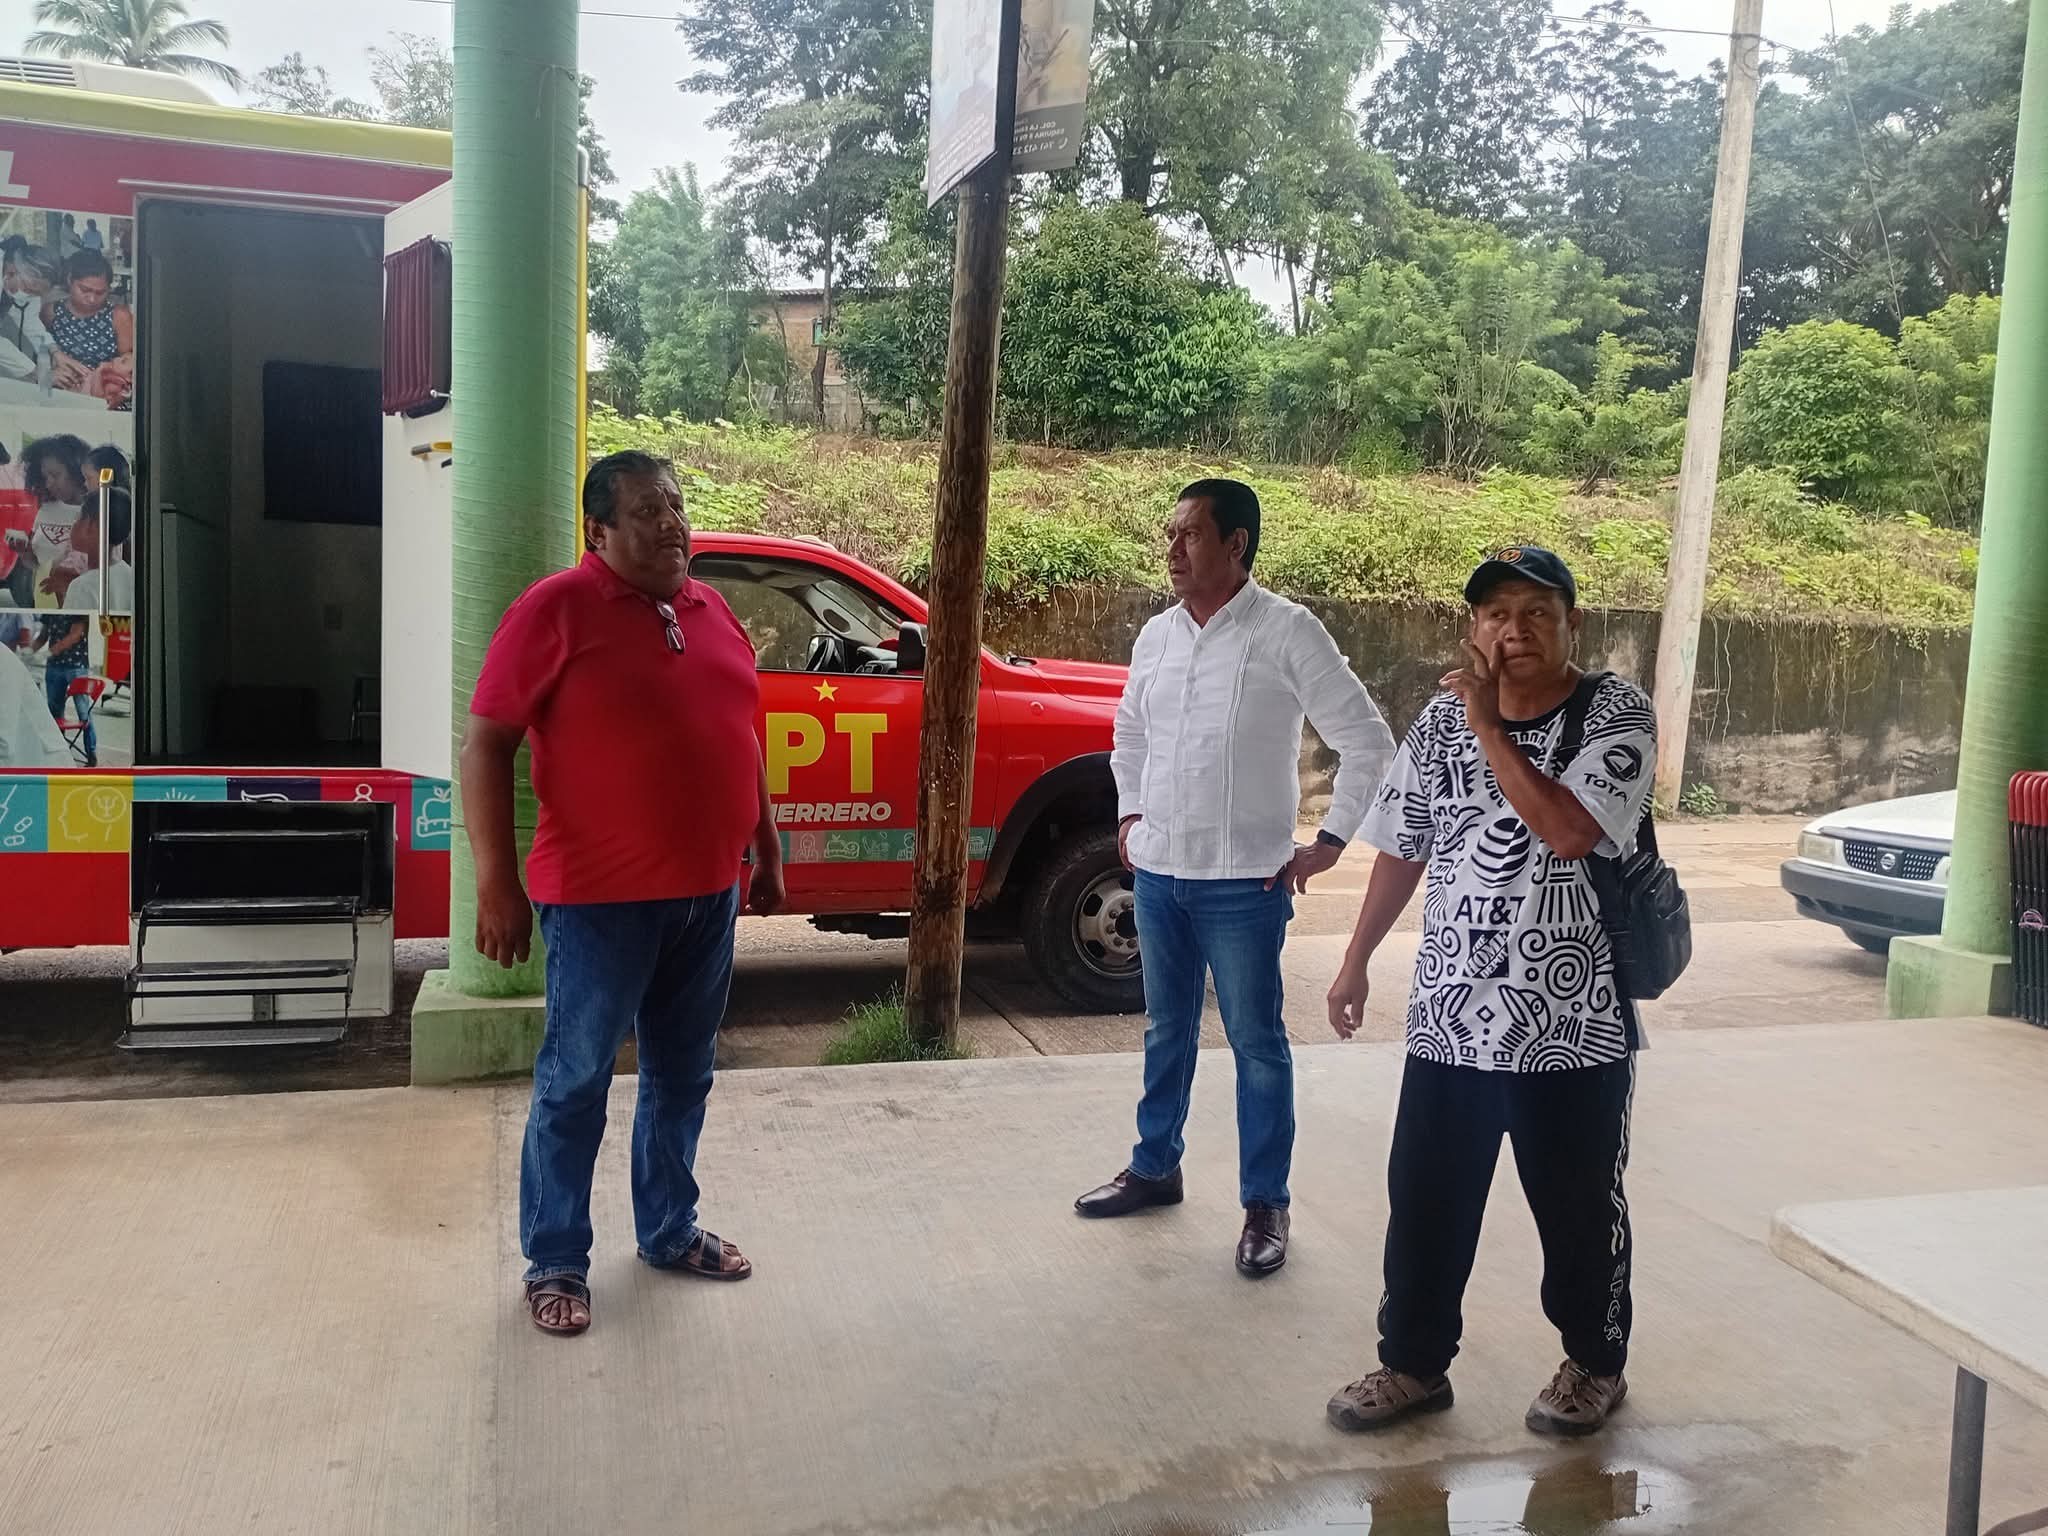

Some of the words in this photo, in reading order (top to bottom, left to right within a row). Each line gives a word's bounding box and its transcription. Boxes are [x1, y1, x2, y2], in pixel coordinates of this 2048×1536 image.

[766, 712, 887, 794] PT
[1584, 772, 1629, 807] TOTA
[770, 802, 892, 823] ERRERO
[1453, 894, 1527, 926] AT&T
[1464, 930, 1509, 978] HOME
[1480, 945, 1509, 979] DEPOT
